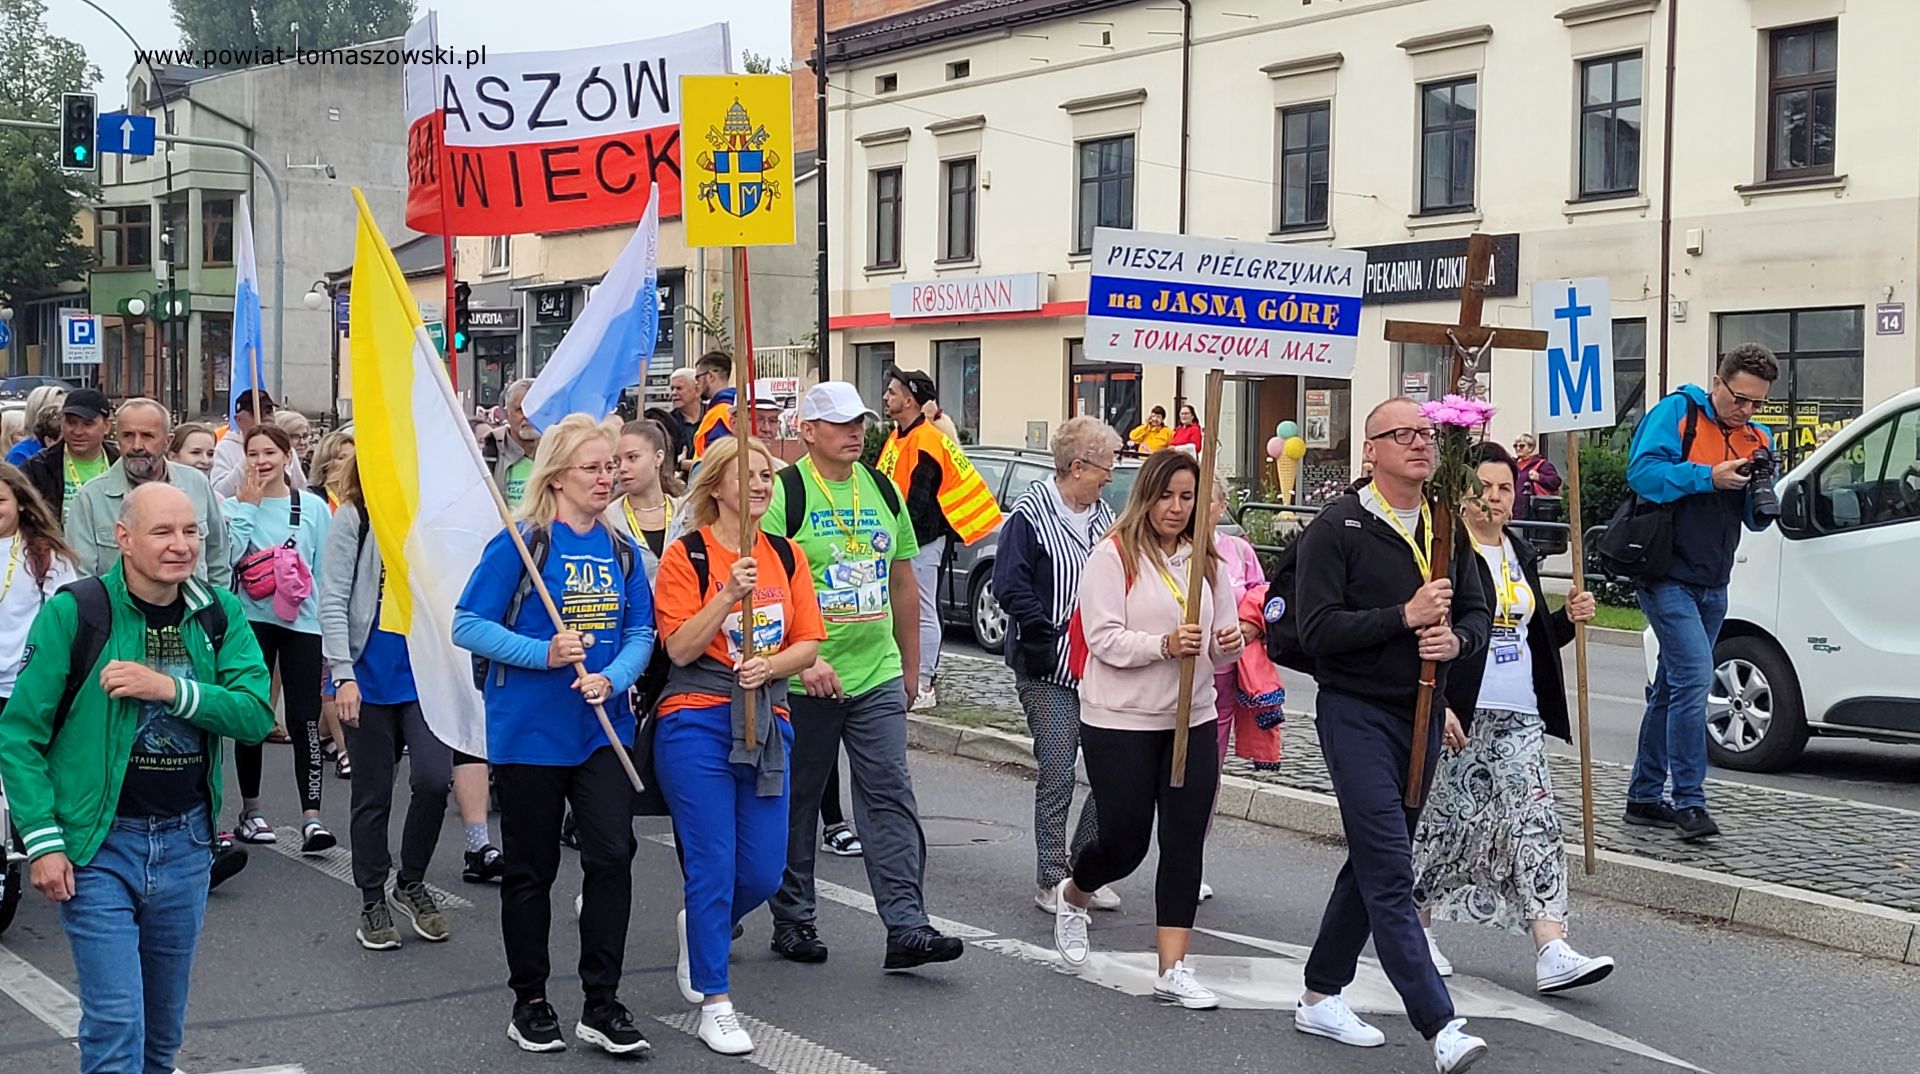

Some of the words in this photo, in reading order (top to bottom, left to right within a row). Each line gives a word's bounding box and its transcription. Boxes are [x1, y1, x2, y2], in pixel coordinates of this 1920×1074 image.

[1108, 245, 1184, 272] PIESZA
[1197, 253, 1352, 286] PIELGRZYMKA
[1366, 259, 1422, 294] PIEKARNIA
[912, 279, 1012, 312] ROSSMANN
[1107, 292, 1142, 310] na
[1151, 289, 1247, 324] JASNĄ
[1257, 294, 1340, 331] GÓRĘ
[74, 321, 90, 342] P
[1881, 315, 1899, 330] 14
[1109, 332, 1121, 347] z
[1133, 328, 1270, 359] TOMASZOWA
[1280, 340, 1332, 364] MAZ.
[565, 562, 614, 588] 205
[308, 769, 322, 800] SHOCK
